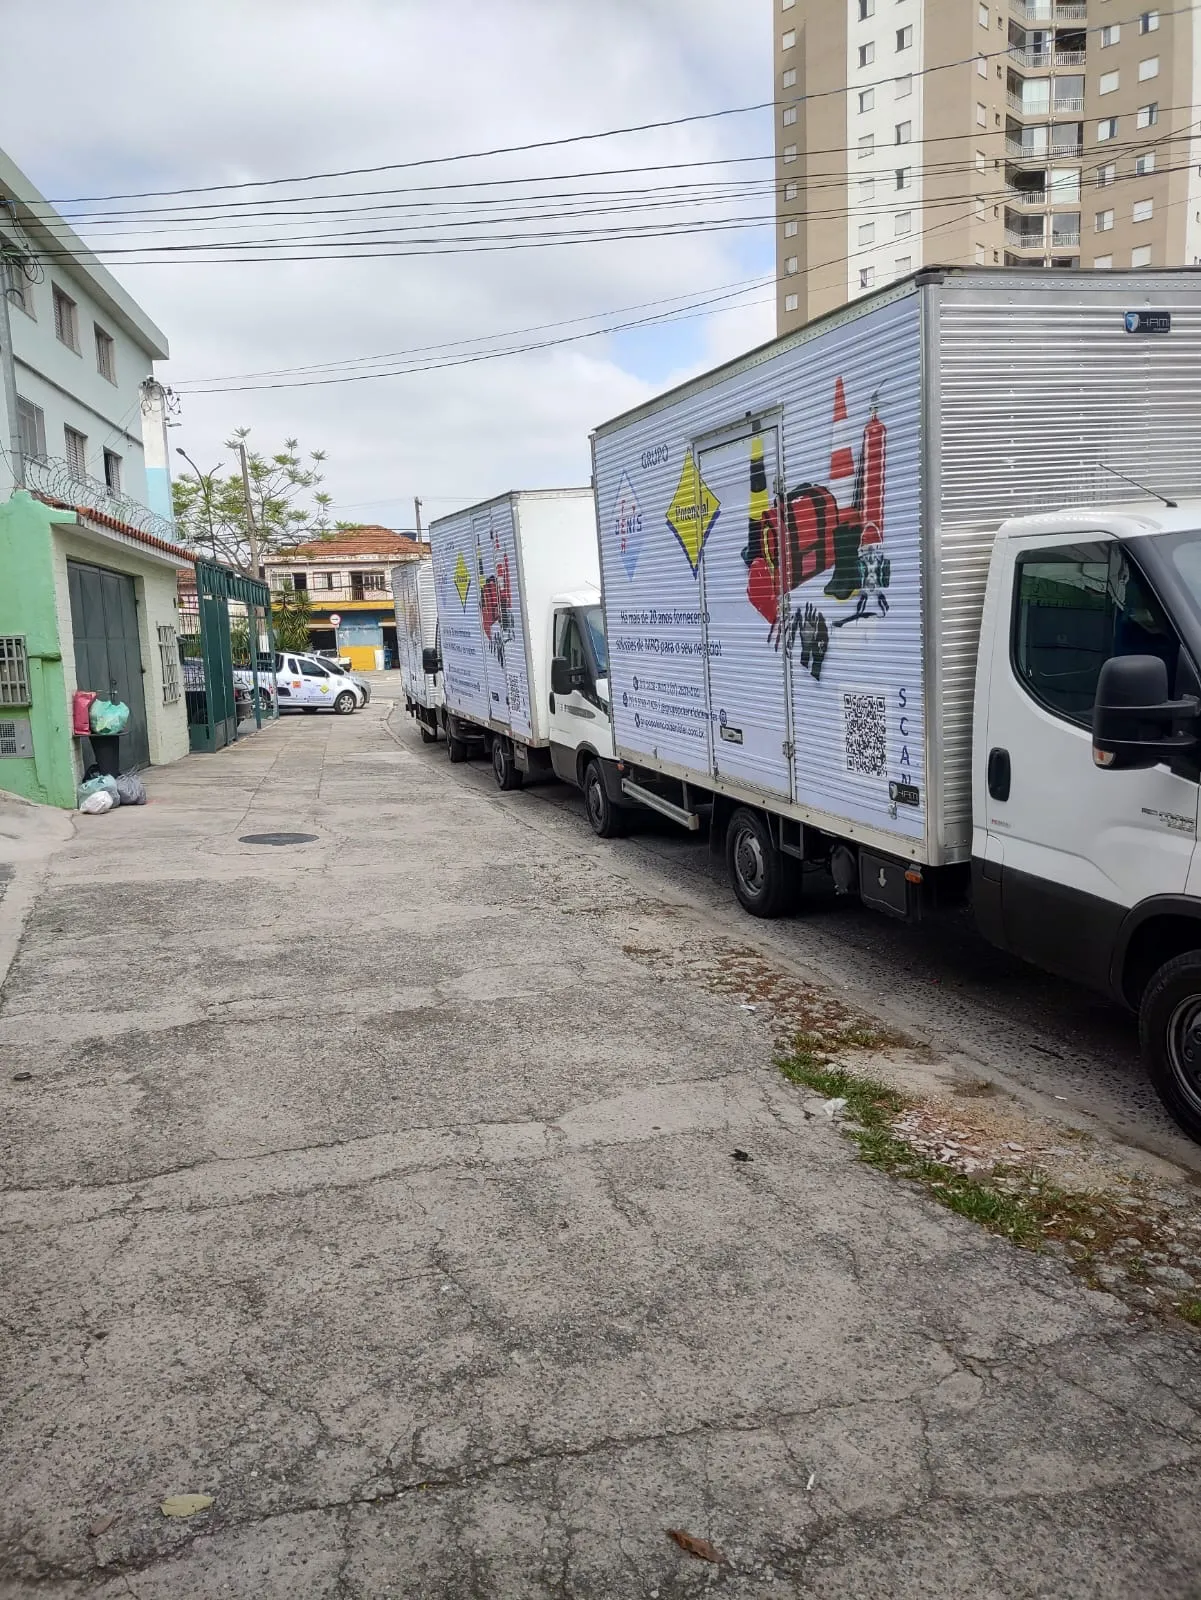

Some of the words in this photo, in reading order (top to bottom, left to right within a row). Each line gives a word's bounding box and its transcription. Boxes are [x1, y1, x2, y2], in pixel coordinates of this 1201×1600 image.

[641, 443, 669, 470] GRUPO
[649, 610, 657, 624] 20
[658, 612, 672, 624] anos
[660, 641, 674, 655] para
[681, 643, 693, 654] seu
